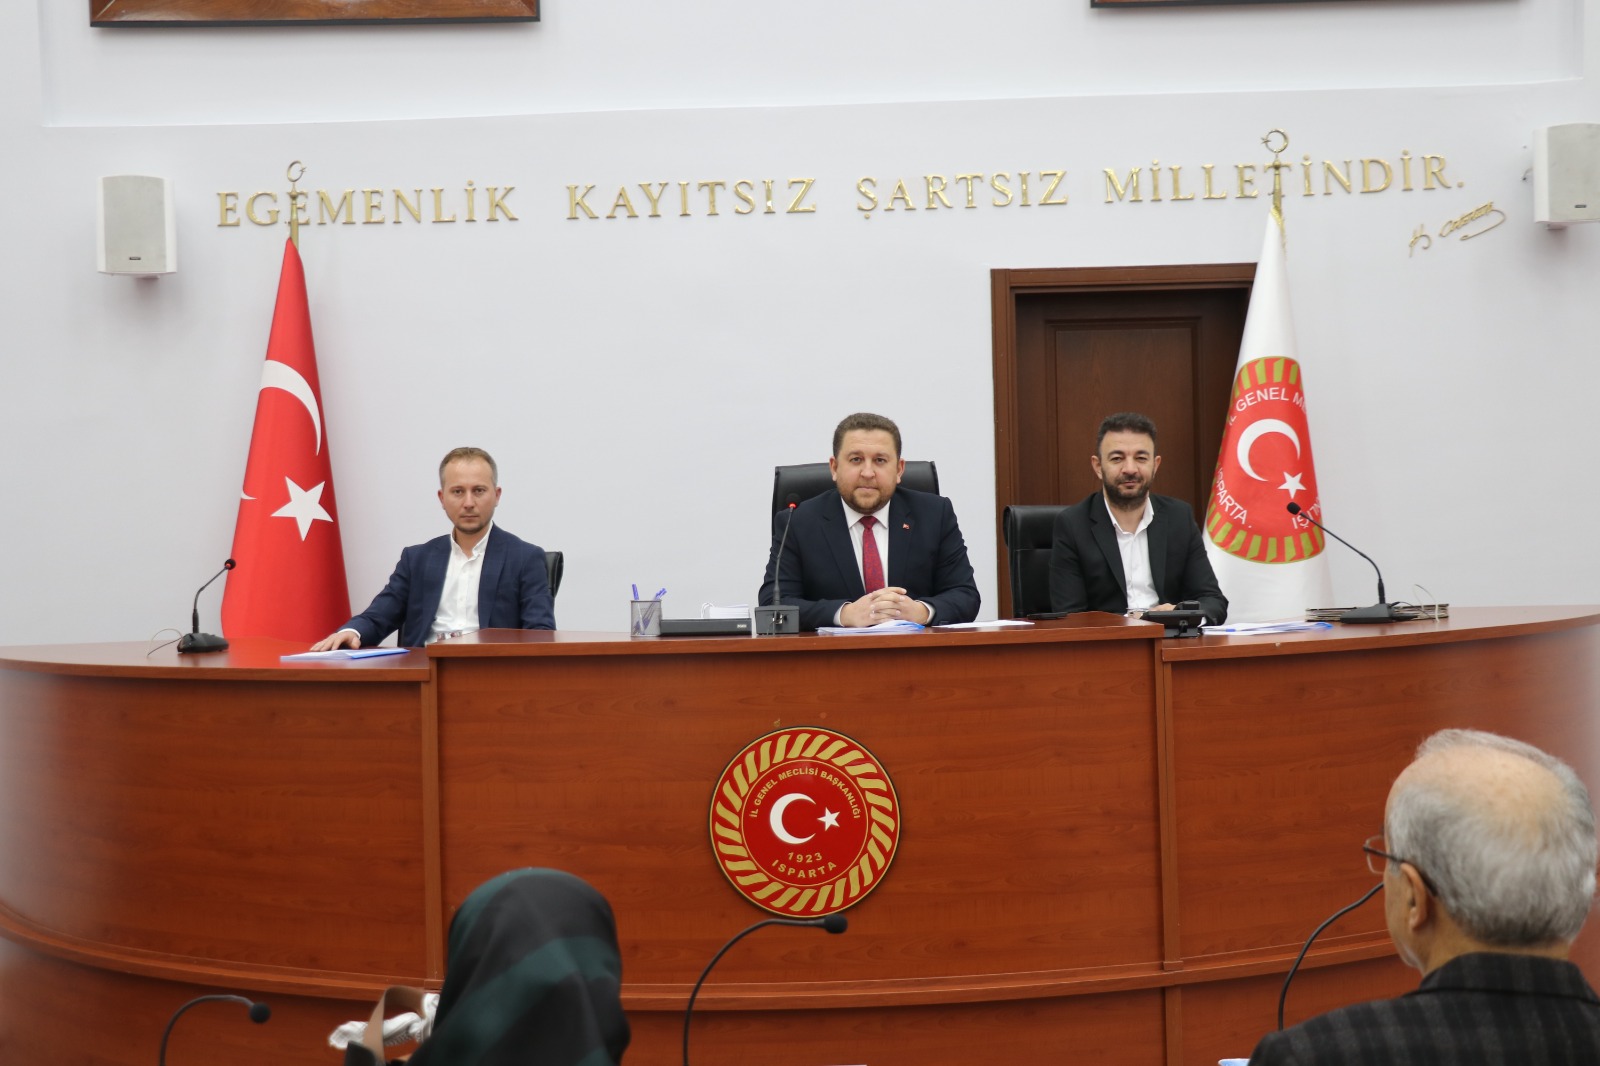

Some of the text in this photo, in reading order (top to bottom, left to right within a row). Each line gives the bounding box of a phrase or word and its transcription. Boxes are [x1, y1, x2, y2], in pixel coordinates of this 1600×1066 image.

[217, 149, 1464, 228] EGEMENLİK KAYITSIZ ŞARTSIZ MİLLETİNDİR.
[1236, 387, 1290, 412] GENEL
[749, 766, 861, 819] İL GENEL MECLİSİ BAŞKANLIĞI
[771, 859, 837, 878] ISPARTA
[787, 851, 823, 863] 1923
